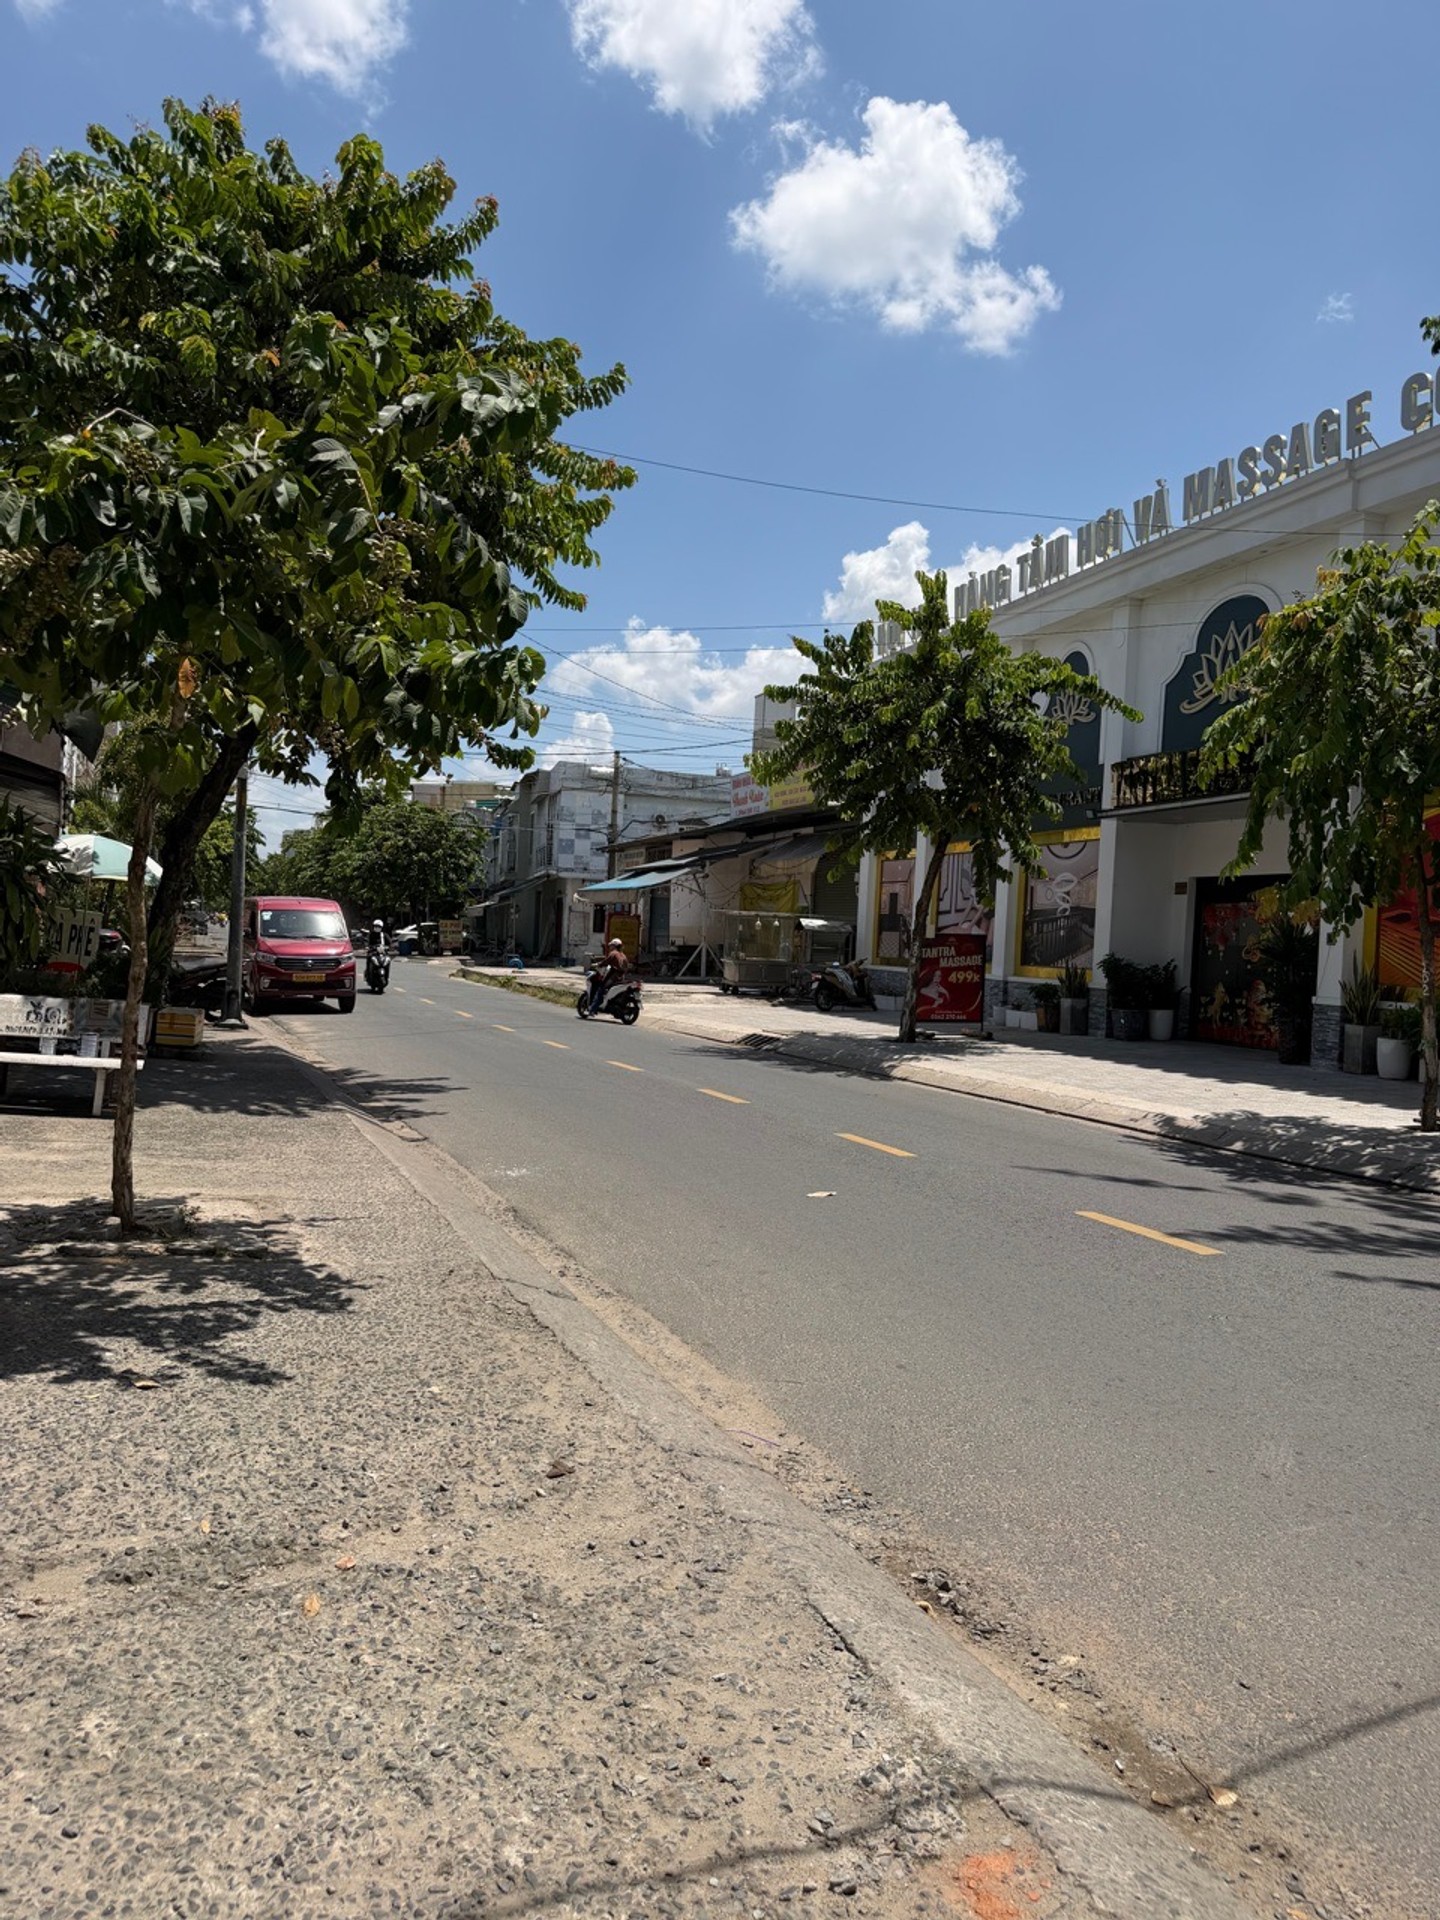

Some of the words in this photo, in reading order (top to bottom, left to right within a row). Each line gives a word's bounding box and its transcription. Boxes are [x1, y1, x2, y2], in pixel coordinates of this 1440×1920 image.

[1077, 508, 1123, 566] HƠI
[1133, 479, 1171, 541] VÀ
[1183, 390, 1372, 521] MASSAGE
[1401, 366, 1440, 431] C
[922, 946, 956, 959] TANTRA
[947, 970, 980, 984] 499k
